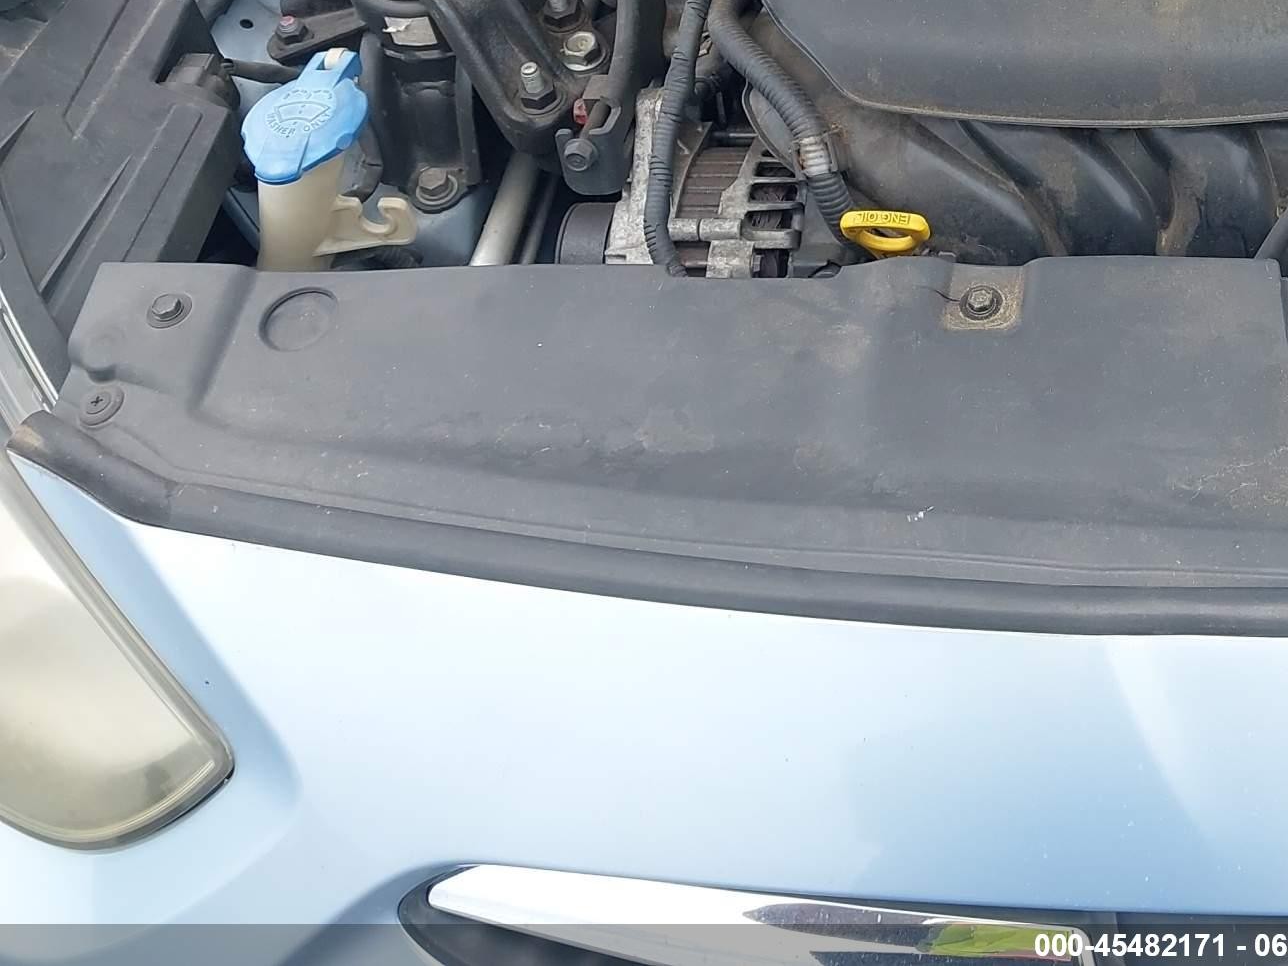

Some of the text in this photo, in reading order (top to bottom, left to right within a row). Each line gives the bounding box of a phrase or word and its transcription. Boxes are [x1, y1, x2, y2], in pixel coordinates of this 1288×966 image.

[266, 112, 331, 135] WASHER ONLY
[856, 212, 911, 225] ENG OIL
